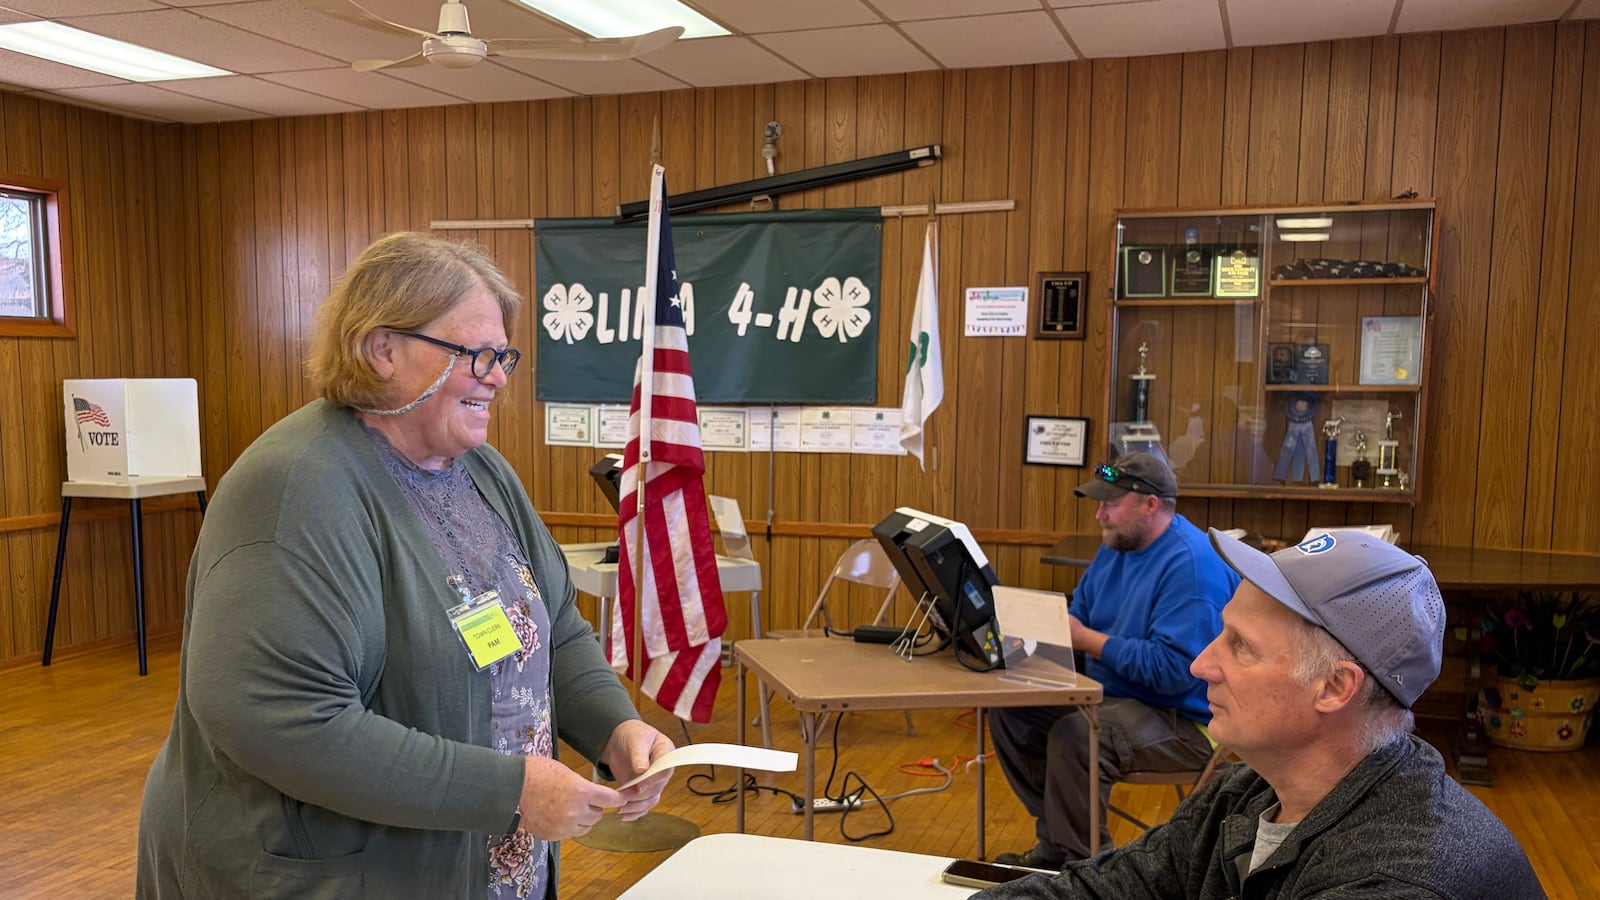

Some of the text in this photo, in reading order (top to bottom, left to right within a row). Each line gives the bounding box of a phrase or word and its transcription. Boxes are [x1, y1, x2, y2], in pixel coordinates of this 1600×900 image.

[728, 282, 812, 342] 4-H
[88, 431, 119, 447] VOTE
[472, 629, 488, 640] TOWN
[487, 638, 500, 648] PAM
